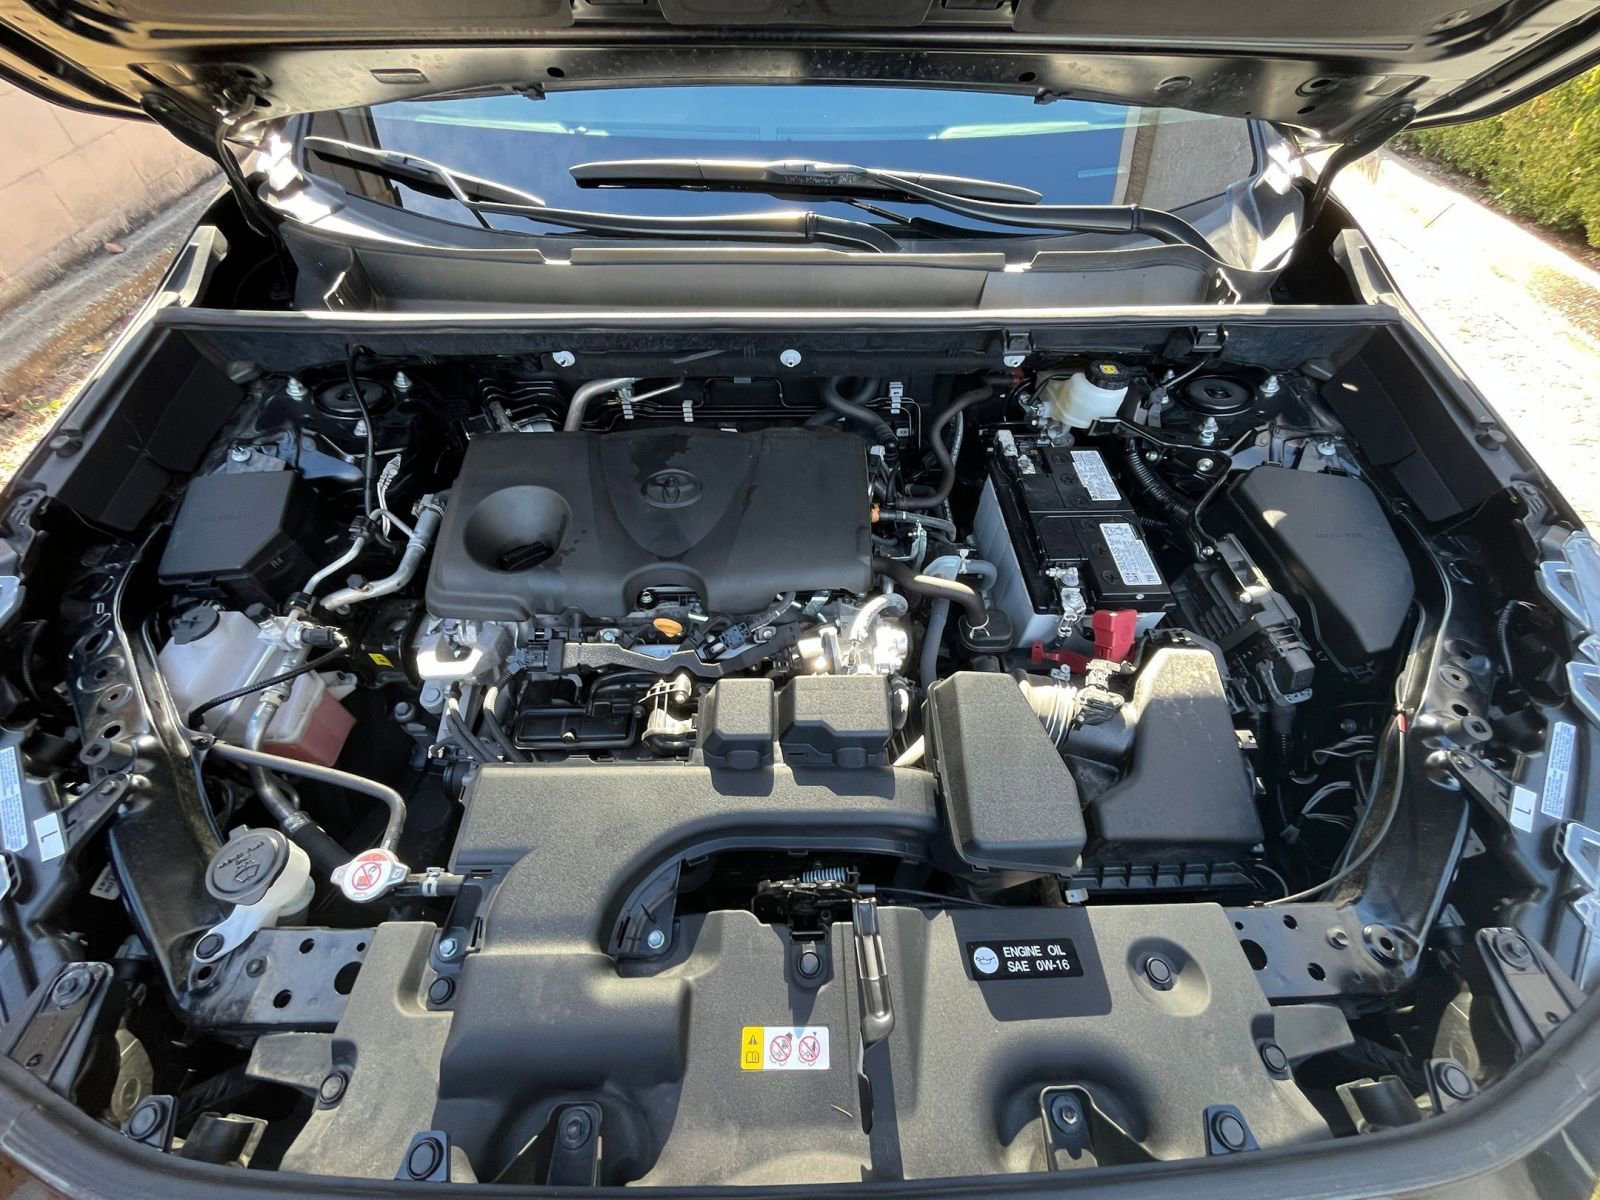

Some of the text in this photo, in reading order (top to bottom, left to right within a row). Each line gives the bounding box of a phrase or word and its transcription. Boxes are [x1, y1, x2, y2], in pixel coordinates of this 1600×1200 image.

[1002, 944, 1067, 958] ENGINE OIL
[1007, 959, 1071, 973] SAE 0W-16
